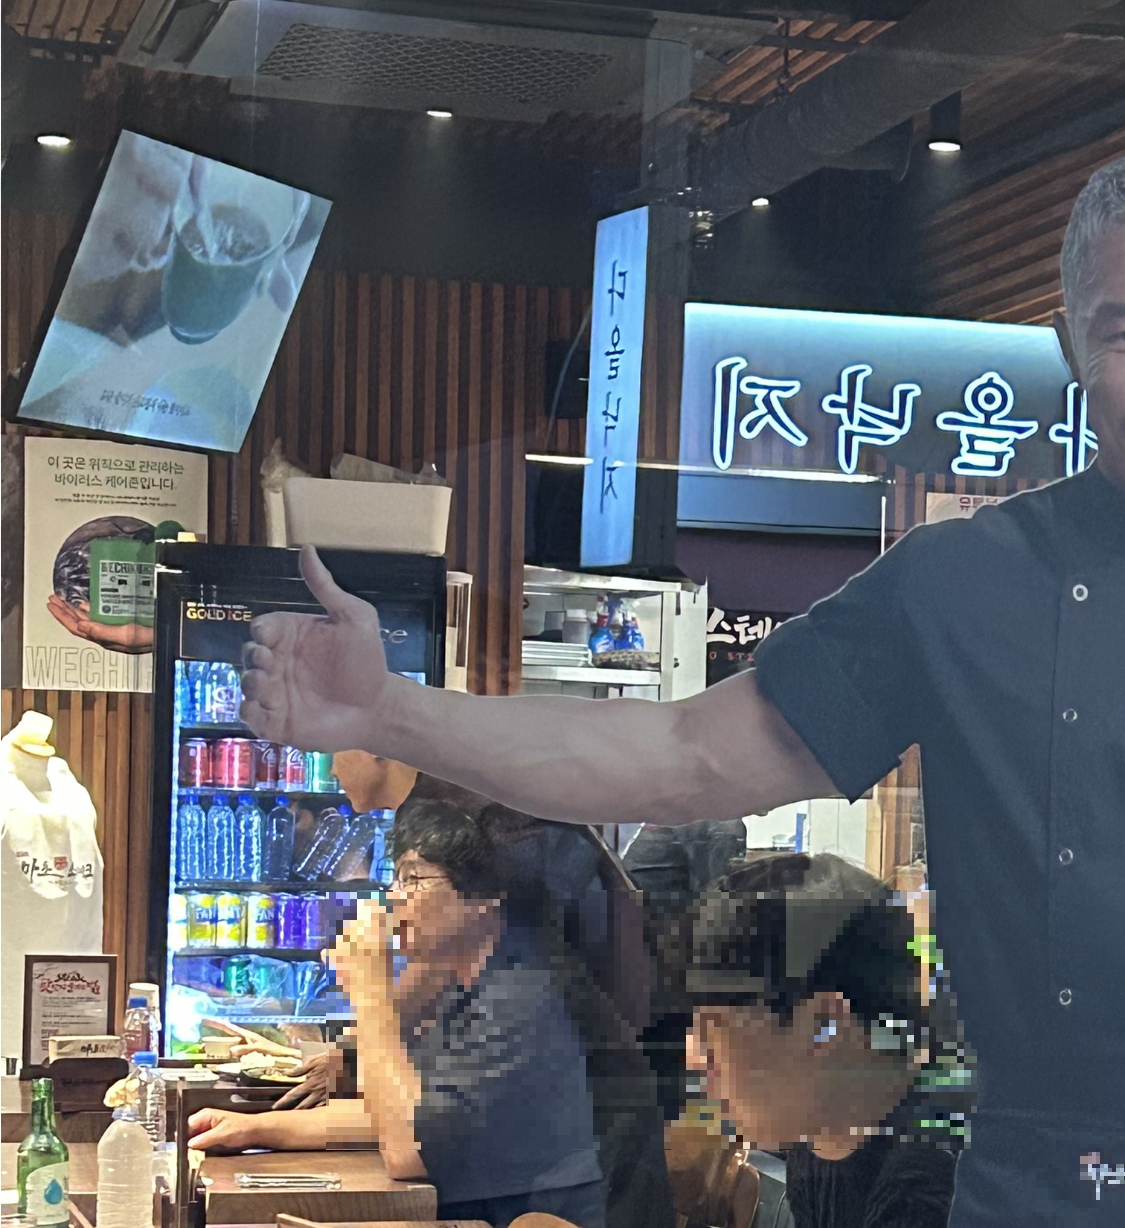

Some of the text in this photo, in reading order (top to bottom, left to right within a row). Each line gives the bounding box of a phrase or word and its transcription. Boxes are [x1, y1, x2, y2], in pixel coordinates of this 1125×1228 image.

[48, 456, 59, 468] 이
[62, 456, 86, 470] 곳은
[139, 460, 184, 475] 관리하는
[186, 607, 252, 622] GOLD ICE
